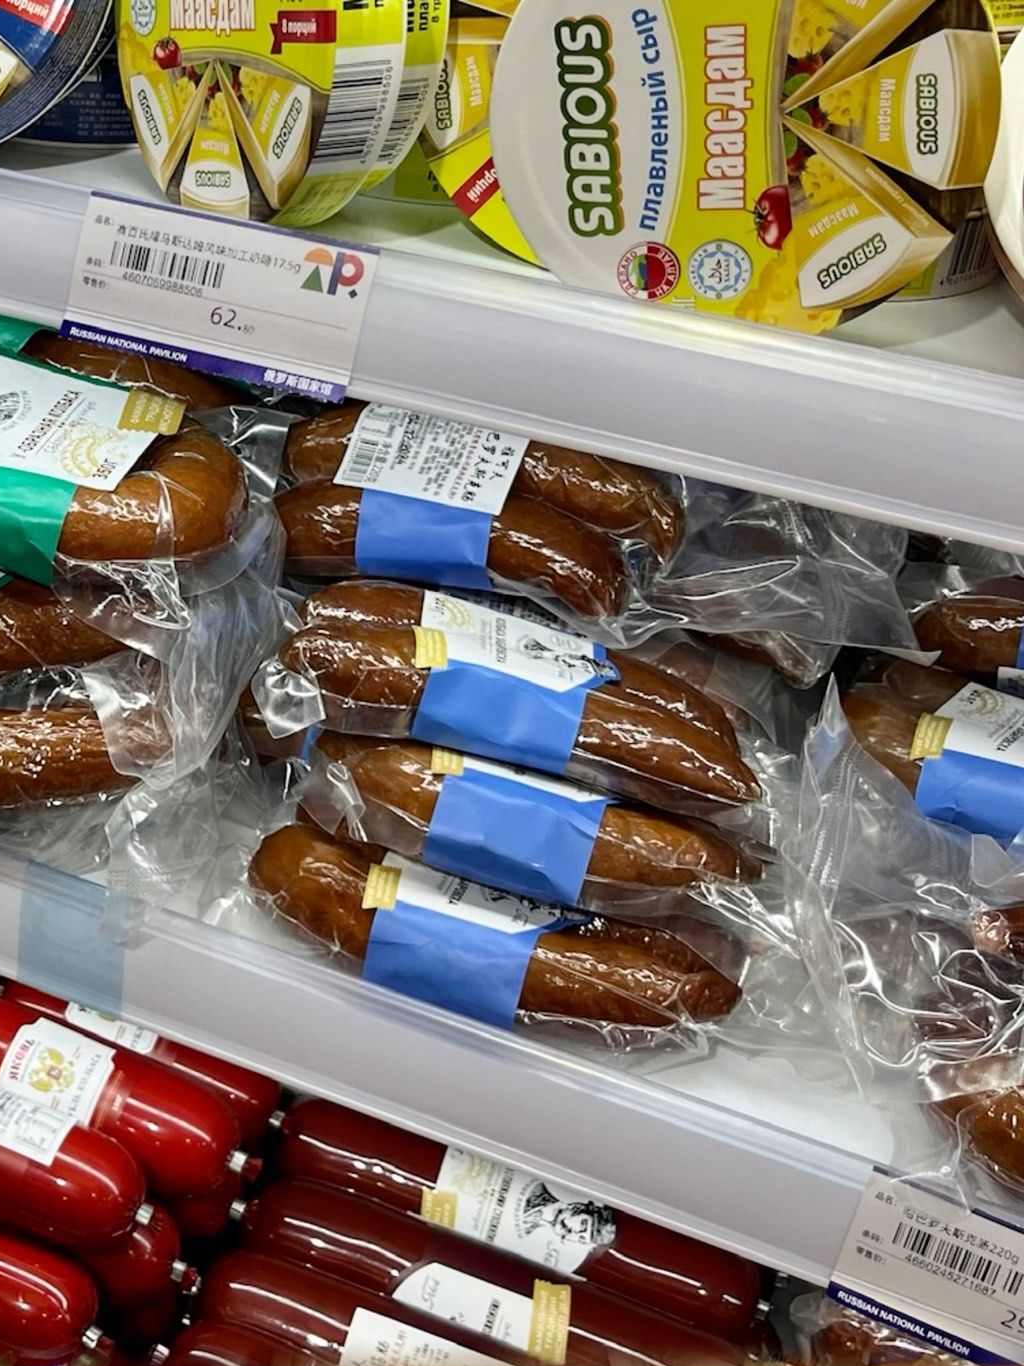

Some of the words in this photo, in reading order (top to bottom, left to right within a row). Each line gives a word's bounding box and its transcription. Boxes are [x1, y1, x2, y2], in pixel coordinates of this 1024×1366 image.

[282, 19, 289, 33] 8
[290, 18, 318, 36] порций
[631, 7, 663, 65] сыр
[469, 55, 486, 108] Маасдам
[878, 78, 897, 143] Маасдам
[137, 89, 162, 146] SABIOUS
[271, 96, 304, 161] SABIOUS
[555, 15, 625, 237] SABIOUS
[697, 24, 754, 211] Маасдам
[916, 73, 939, 155] SABIOUS
[195, 169, 232, 189] SABIOUS
[639, 70, 669, 231] плавленый
[808, 200, 859, 238] Маасдам
[816, 232, 888, 290] SABIOUS
[70, 326, 106, 343] RUSSIAN
[107, 334, 148, 354] NATIONAL
[149, 344, 188, 363] PAVILION
[210, 306, 255, 336] 62.80
[263, 368, 334, 396] 俄罗斯国家馆
[837, 1290, 879, 1316] RUSSIAN
[879, 1306, 926, 1337] NATIONAL
[926, 1330, 970, 1356] PAVILION
